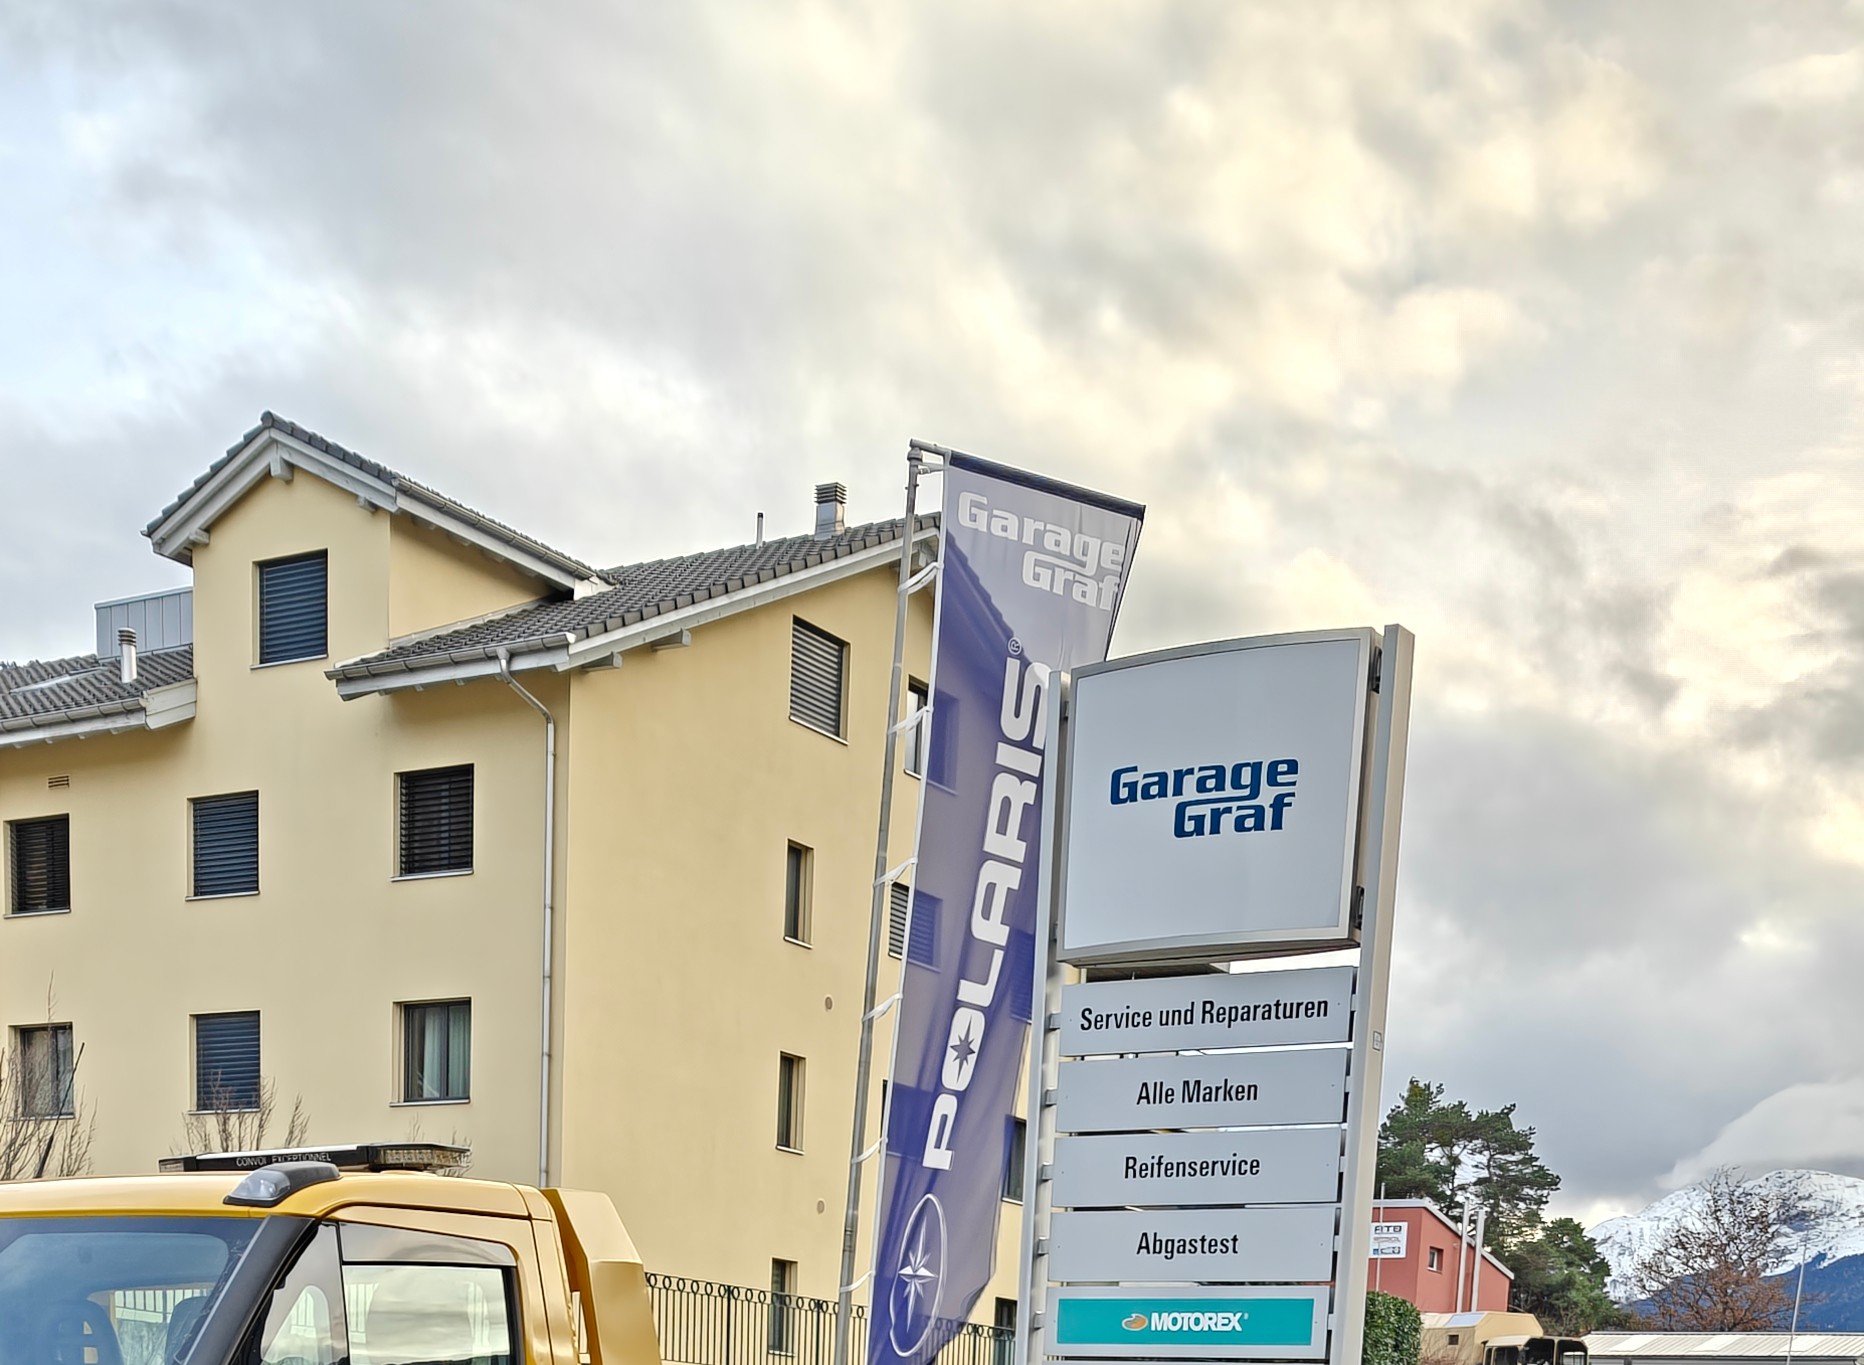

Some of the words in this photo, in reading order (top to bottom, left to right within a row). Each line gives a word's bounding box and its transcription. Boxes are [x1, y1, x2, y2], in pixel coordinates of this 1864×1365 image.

[958, 491, 1126, 576] Garage
[1022, 550, 1121, 612] Graf
[1110, 758, 1299, 806] Garage
[1173, 791, 1296, 839] Graf
[923, 656, 1051, 1171] POLARIS
[1080, 1005, 1152, 1031] Service
[1158, 1001, 1195, 1027] und
[1201, 999, 1329, 1029] Reparaturen
[1136, 1081, 1175, 1106] Alle
[1181, 1078, 1259, 1104] Marken
[1124, 1152, 1261, 1179] Reifenservice
[1136, 1231, 1239, 1261] Abgastest
[1150, 1312, 1243, 1332] MOTOREX
